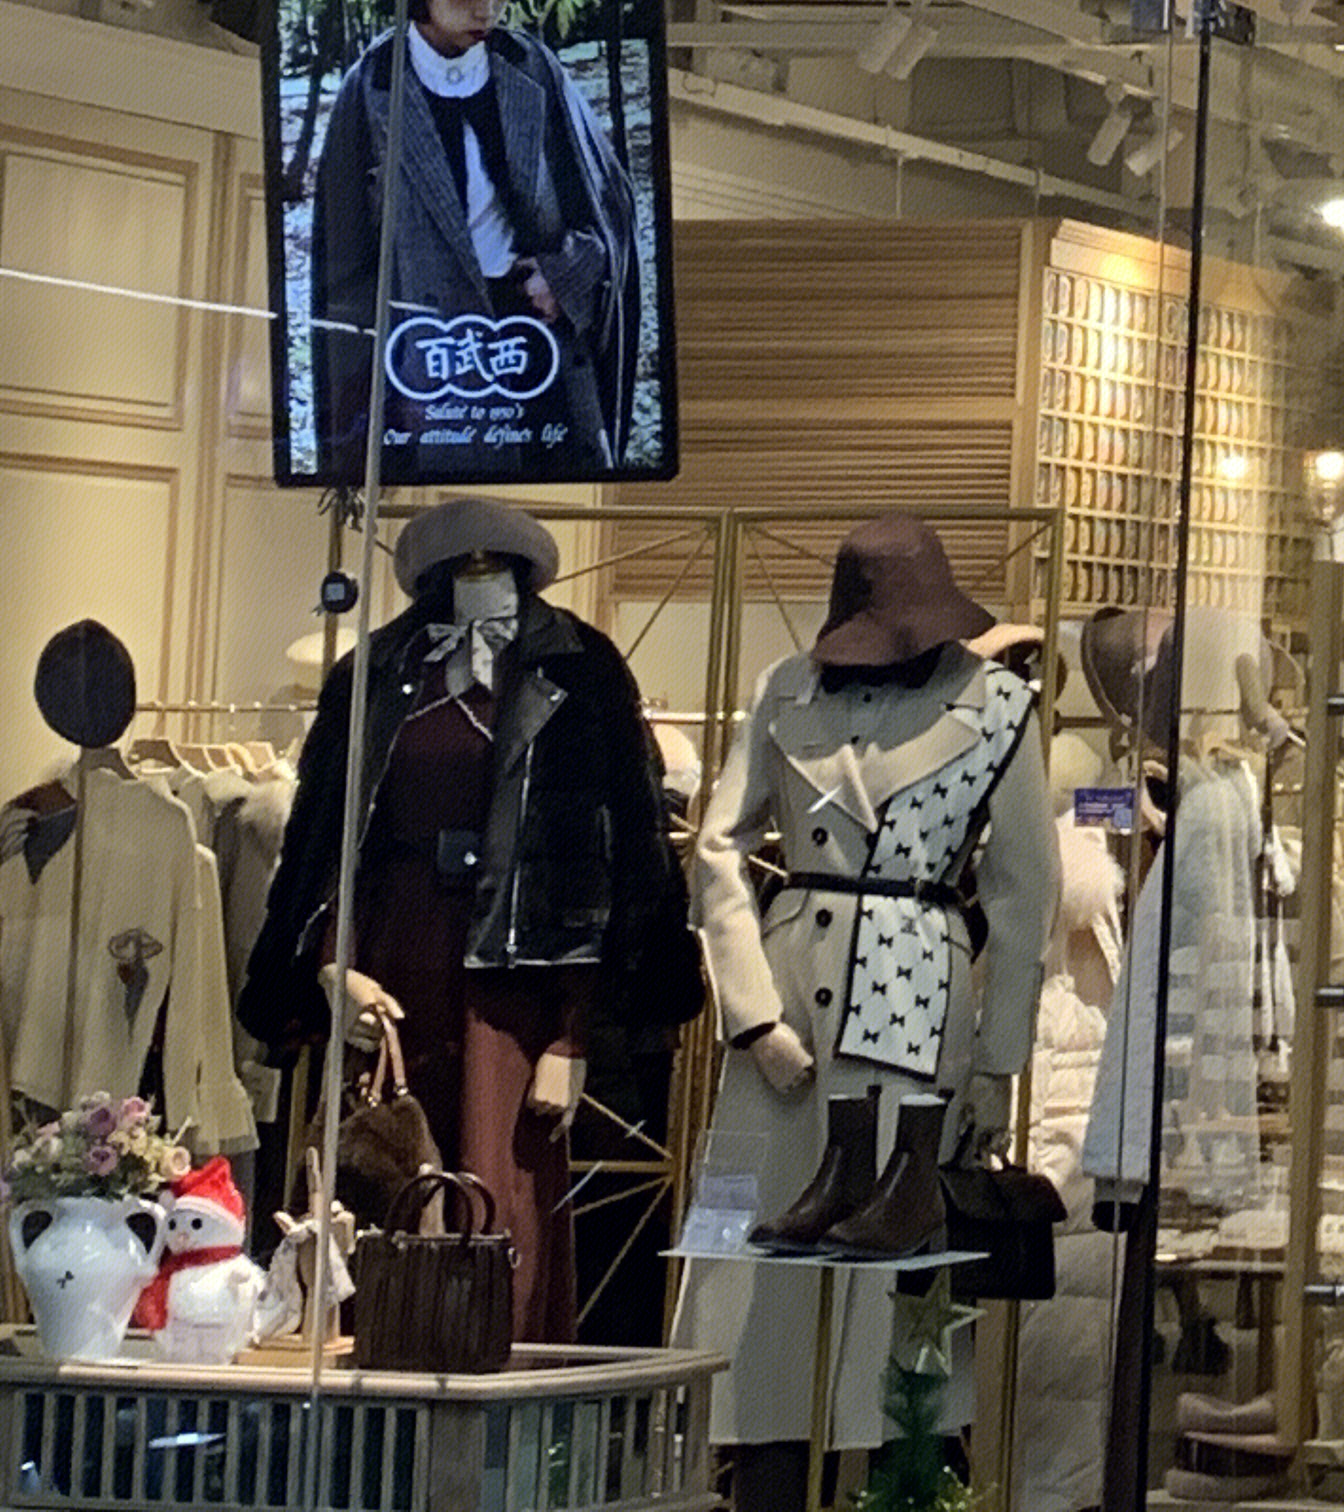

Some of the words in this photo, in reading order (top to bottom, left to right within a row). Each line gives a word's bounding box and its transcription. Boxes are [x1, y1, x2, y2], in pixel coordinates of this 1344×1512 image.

[415, 328, 528, 382] 百武西
[425, 402, 468, 420] Salute
[470, 405, 486, 420] to
[383, 429, 412, 445] Our
[419, 425, 477, 443] attitude
[541, 423, 568, 448] life
